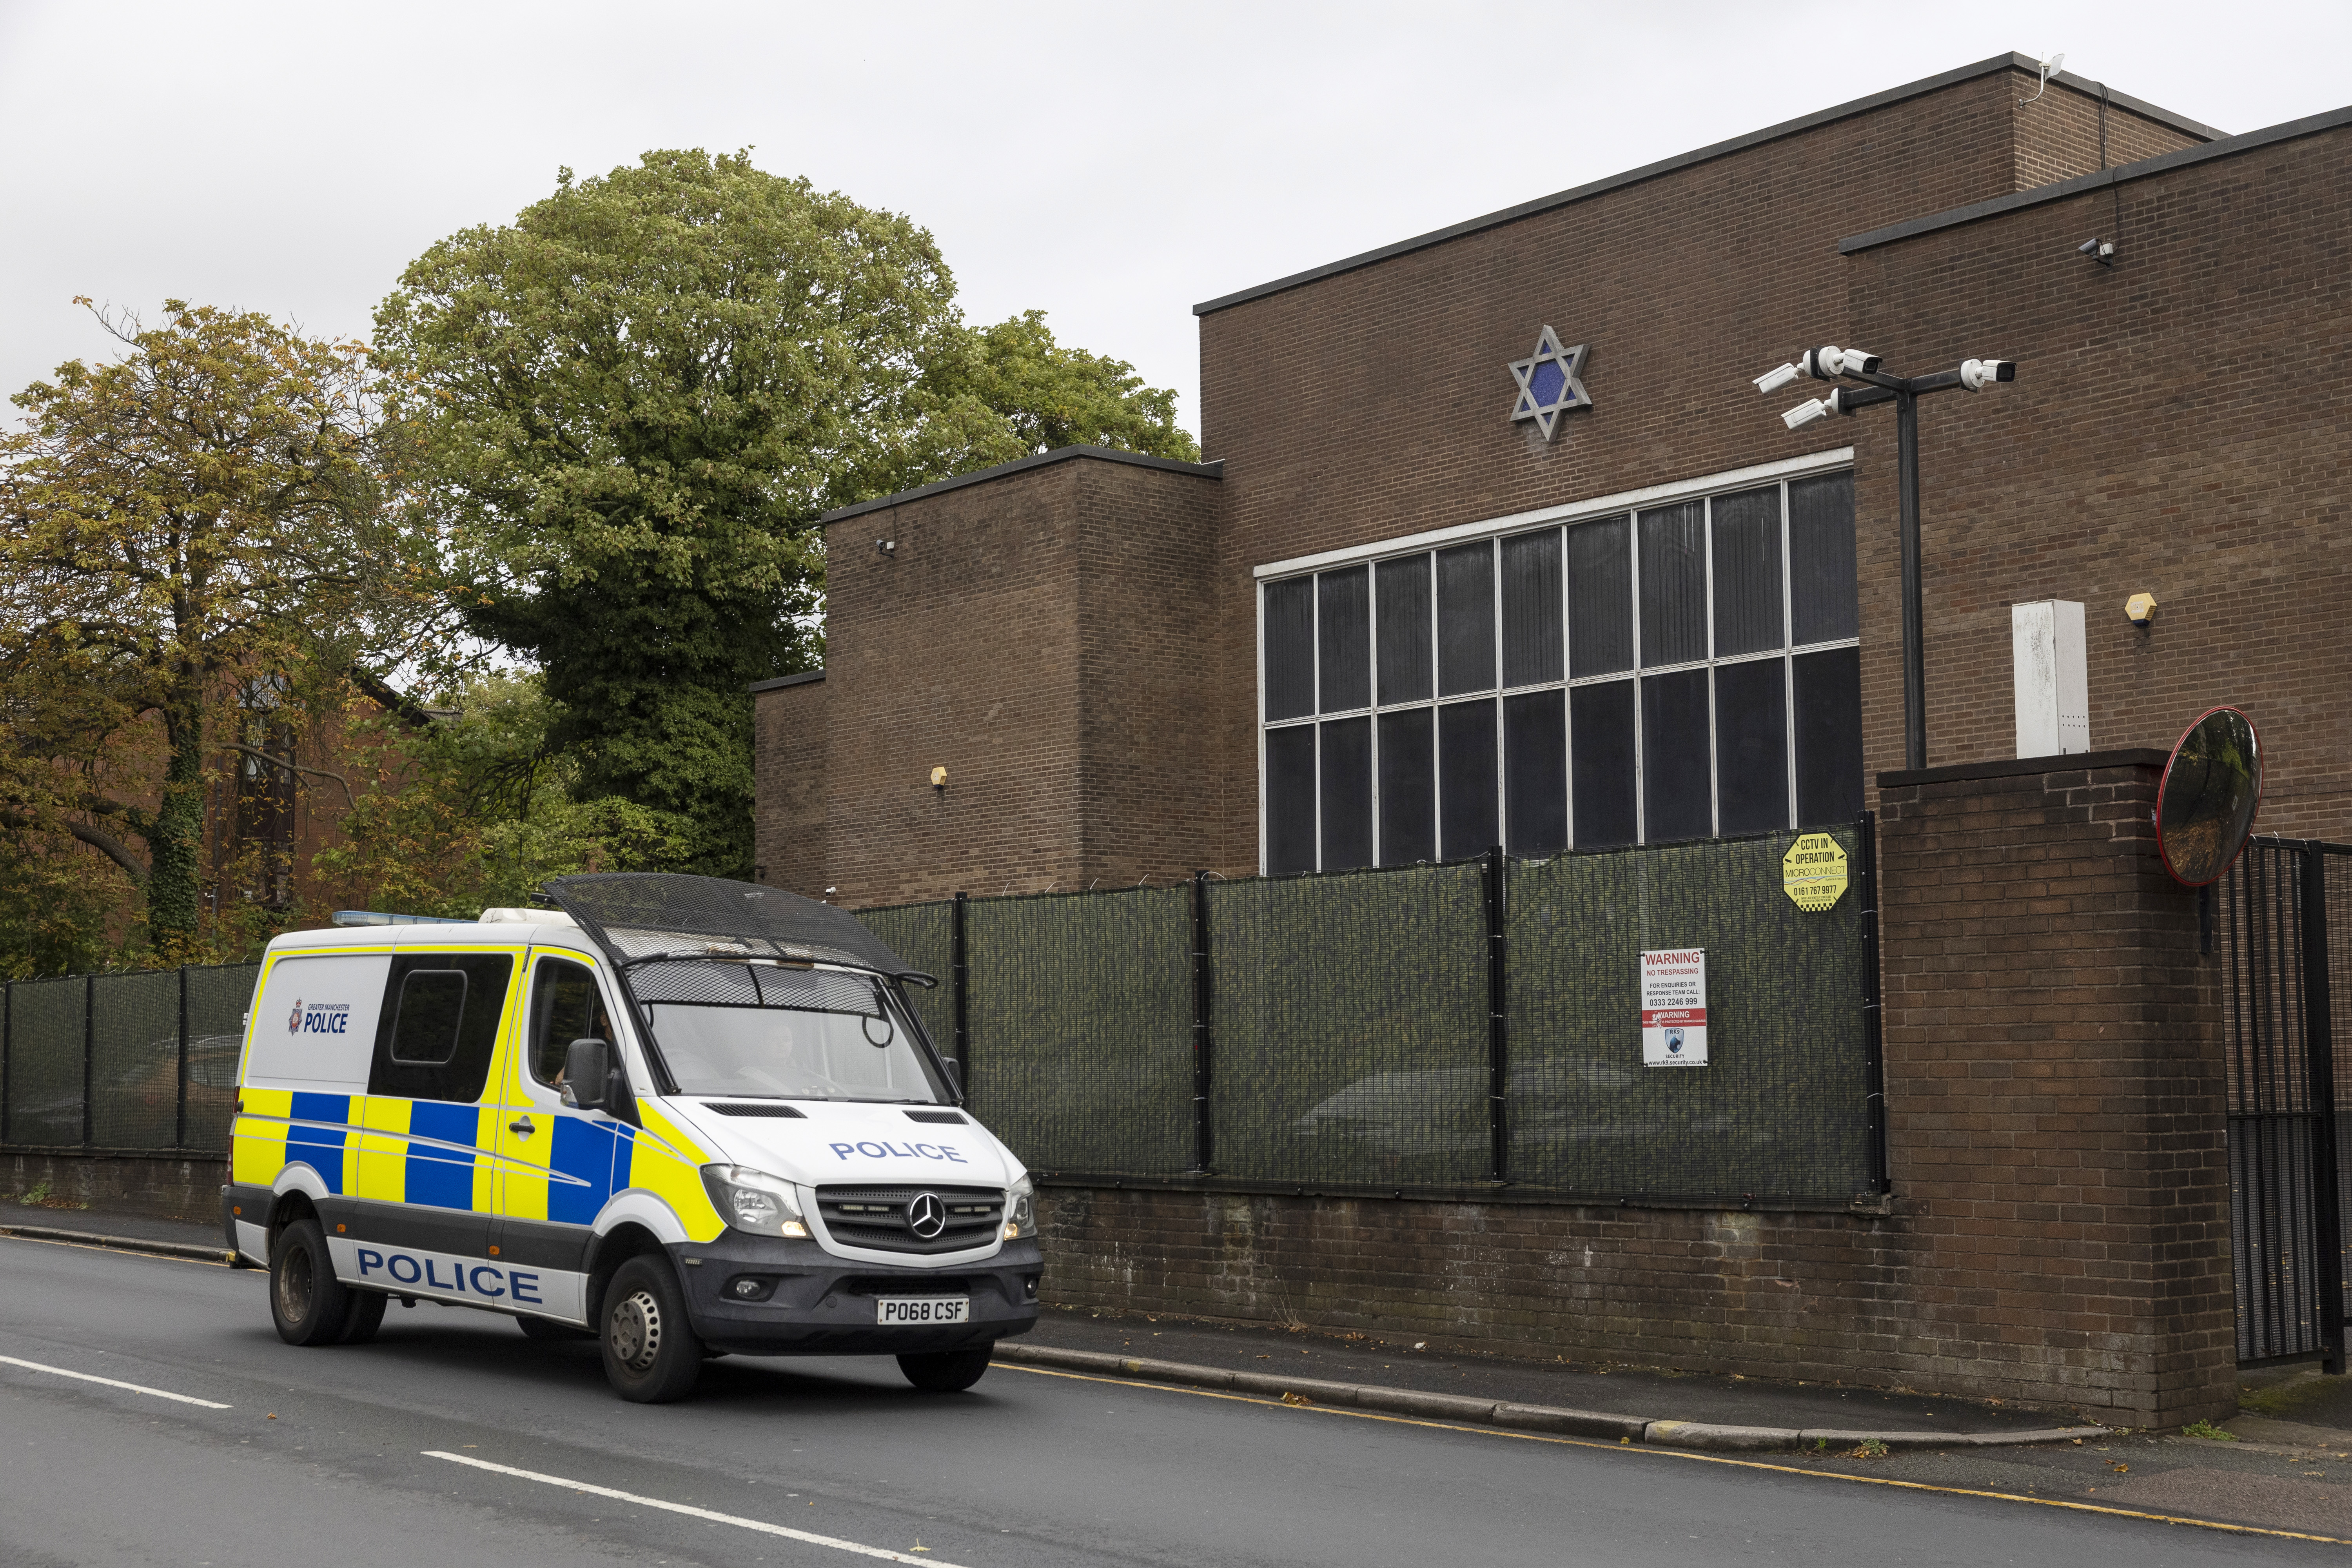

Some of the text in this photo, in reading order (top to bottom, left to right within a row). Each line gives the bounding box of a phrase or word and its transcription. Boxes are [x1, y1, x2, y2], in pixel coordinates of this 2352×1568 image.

[1801, 837, 1828, 850] CCTV IN
[1795, 851, 1835, 864] OPERATION
[1785, 866, 1846, 877] MICROCONNECT
[1794, 885, 1837, 896] 0161 767 9977
[1645, 951, 1700, 965] WARNING
[1658, 1011, 1690, 1019] WARNING
[303, 1012, 348, 1033] POLICE
[828, 1142, 969, 1163] POLICE
[358, 1248, 543, 1304] POLICE
[886, 1301, 963, 1321] PO68 CSF
